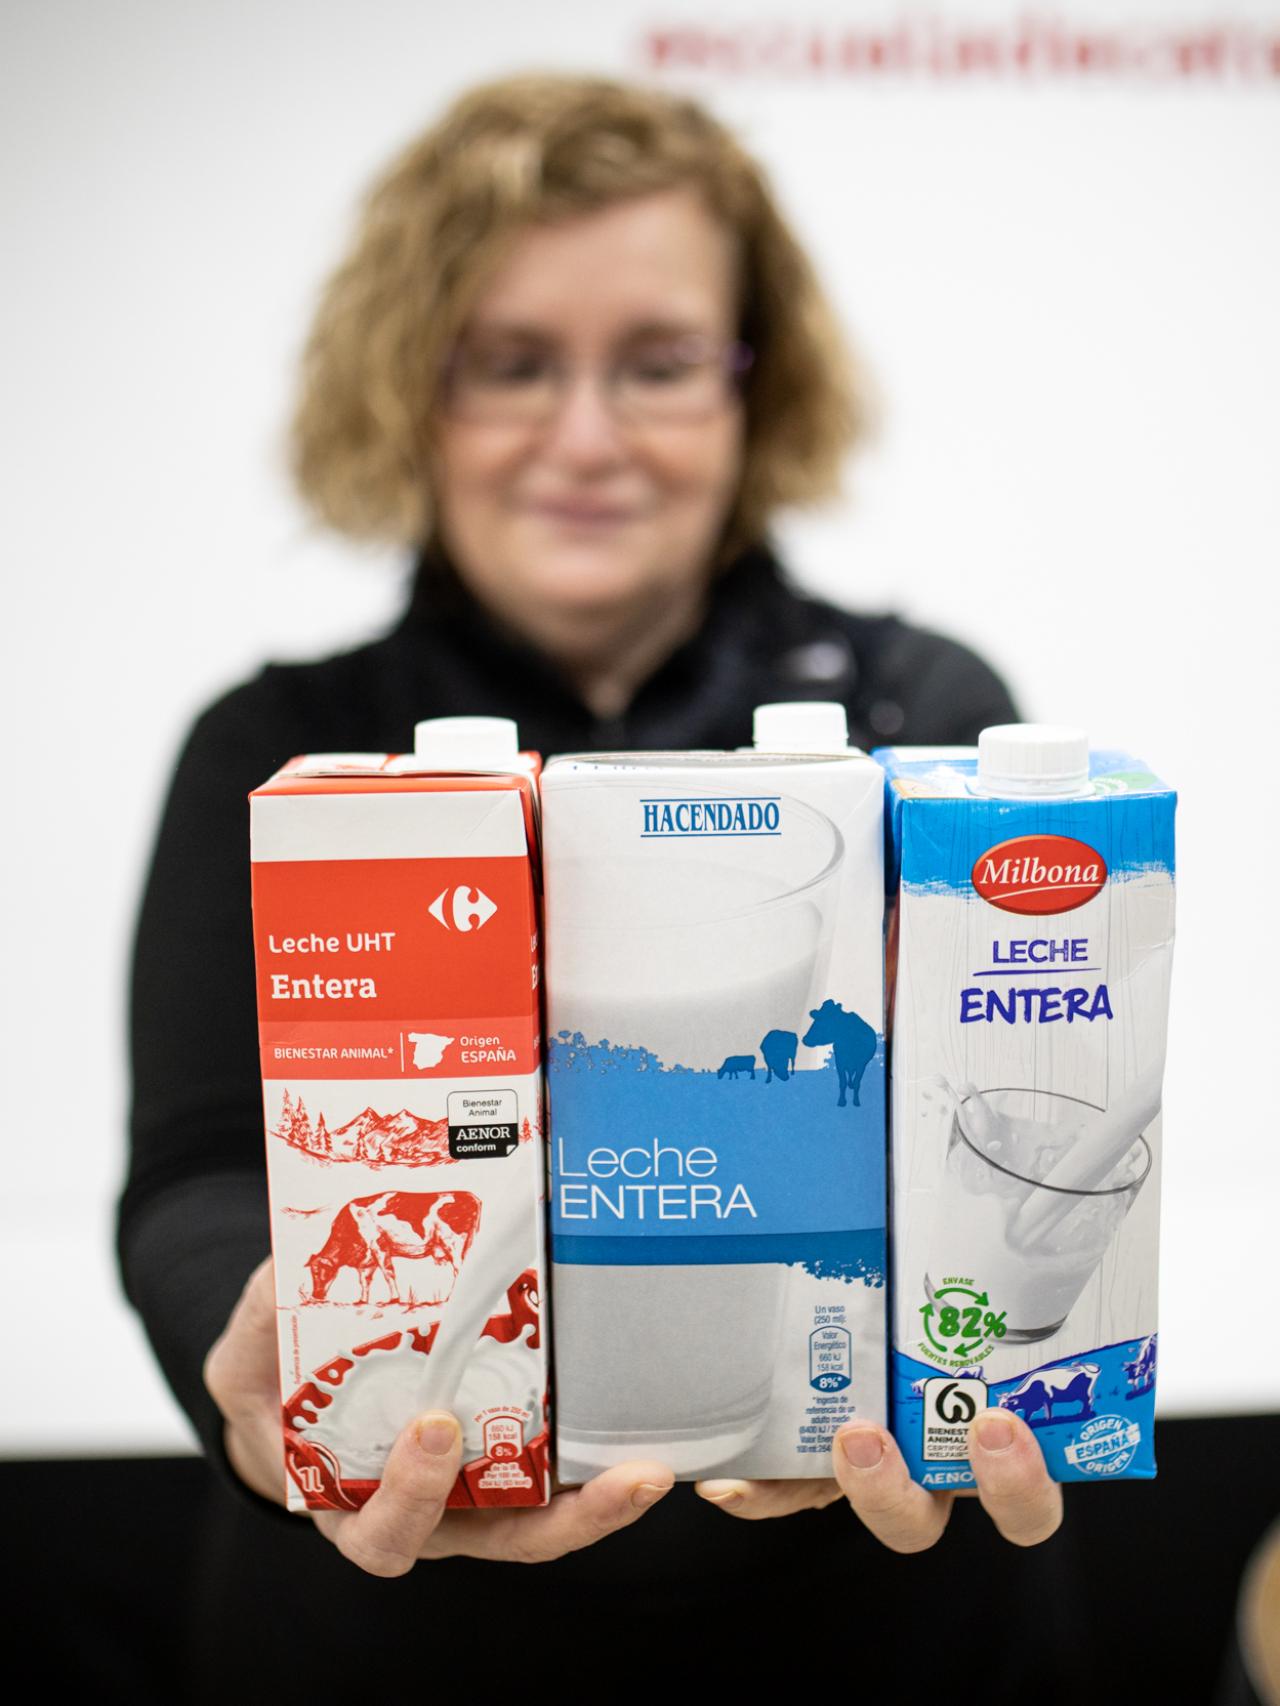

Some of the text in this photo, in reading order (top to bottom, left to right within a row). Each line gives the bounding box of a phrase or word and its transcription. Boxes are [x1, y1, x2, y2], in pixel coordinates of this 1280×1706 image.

[643, 802, 780, 832] HACENDADO
[980, 857, 1100, 885] Milbona
[268, 932, 396, 954] Leche UHT
[992, 938, 1089, 963] LECHE
[271, 974, 377, 999] Entera
[959, 984, 1114, 1025] ENTERA
[460, 1035, 500, 1048] Origen
[274, 1047, 338, 1060] BIENESTAR
[461, 1046, 516, 1064] ESPAÑA
[462, 1099, 503, 1108] Bienestar
[468, 1108, 498, 1117] Animal
[456, 1126, 511, 1141] AENOR
[456, 1143, 497, 1153] conform
[558, 1137, 718, 1178] Leche
[560, 1184, 758, 1220] ENTERA
[943, 1277, 974, 1286] ENVASE
[815, 1305, 846, 1314] Un vaso
[938, 1306, 1007, 1338] 82%
[928, 1427, 969, 1436] BIENEST
[1080, 1418, 1123, 1441] ORIGEN
[1076, 1433, 1131, 1459] ESPAÑA
[1086, 1451, 1131, 1473] ORIGEN
[921, 1471, 974, 1485] AENO
